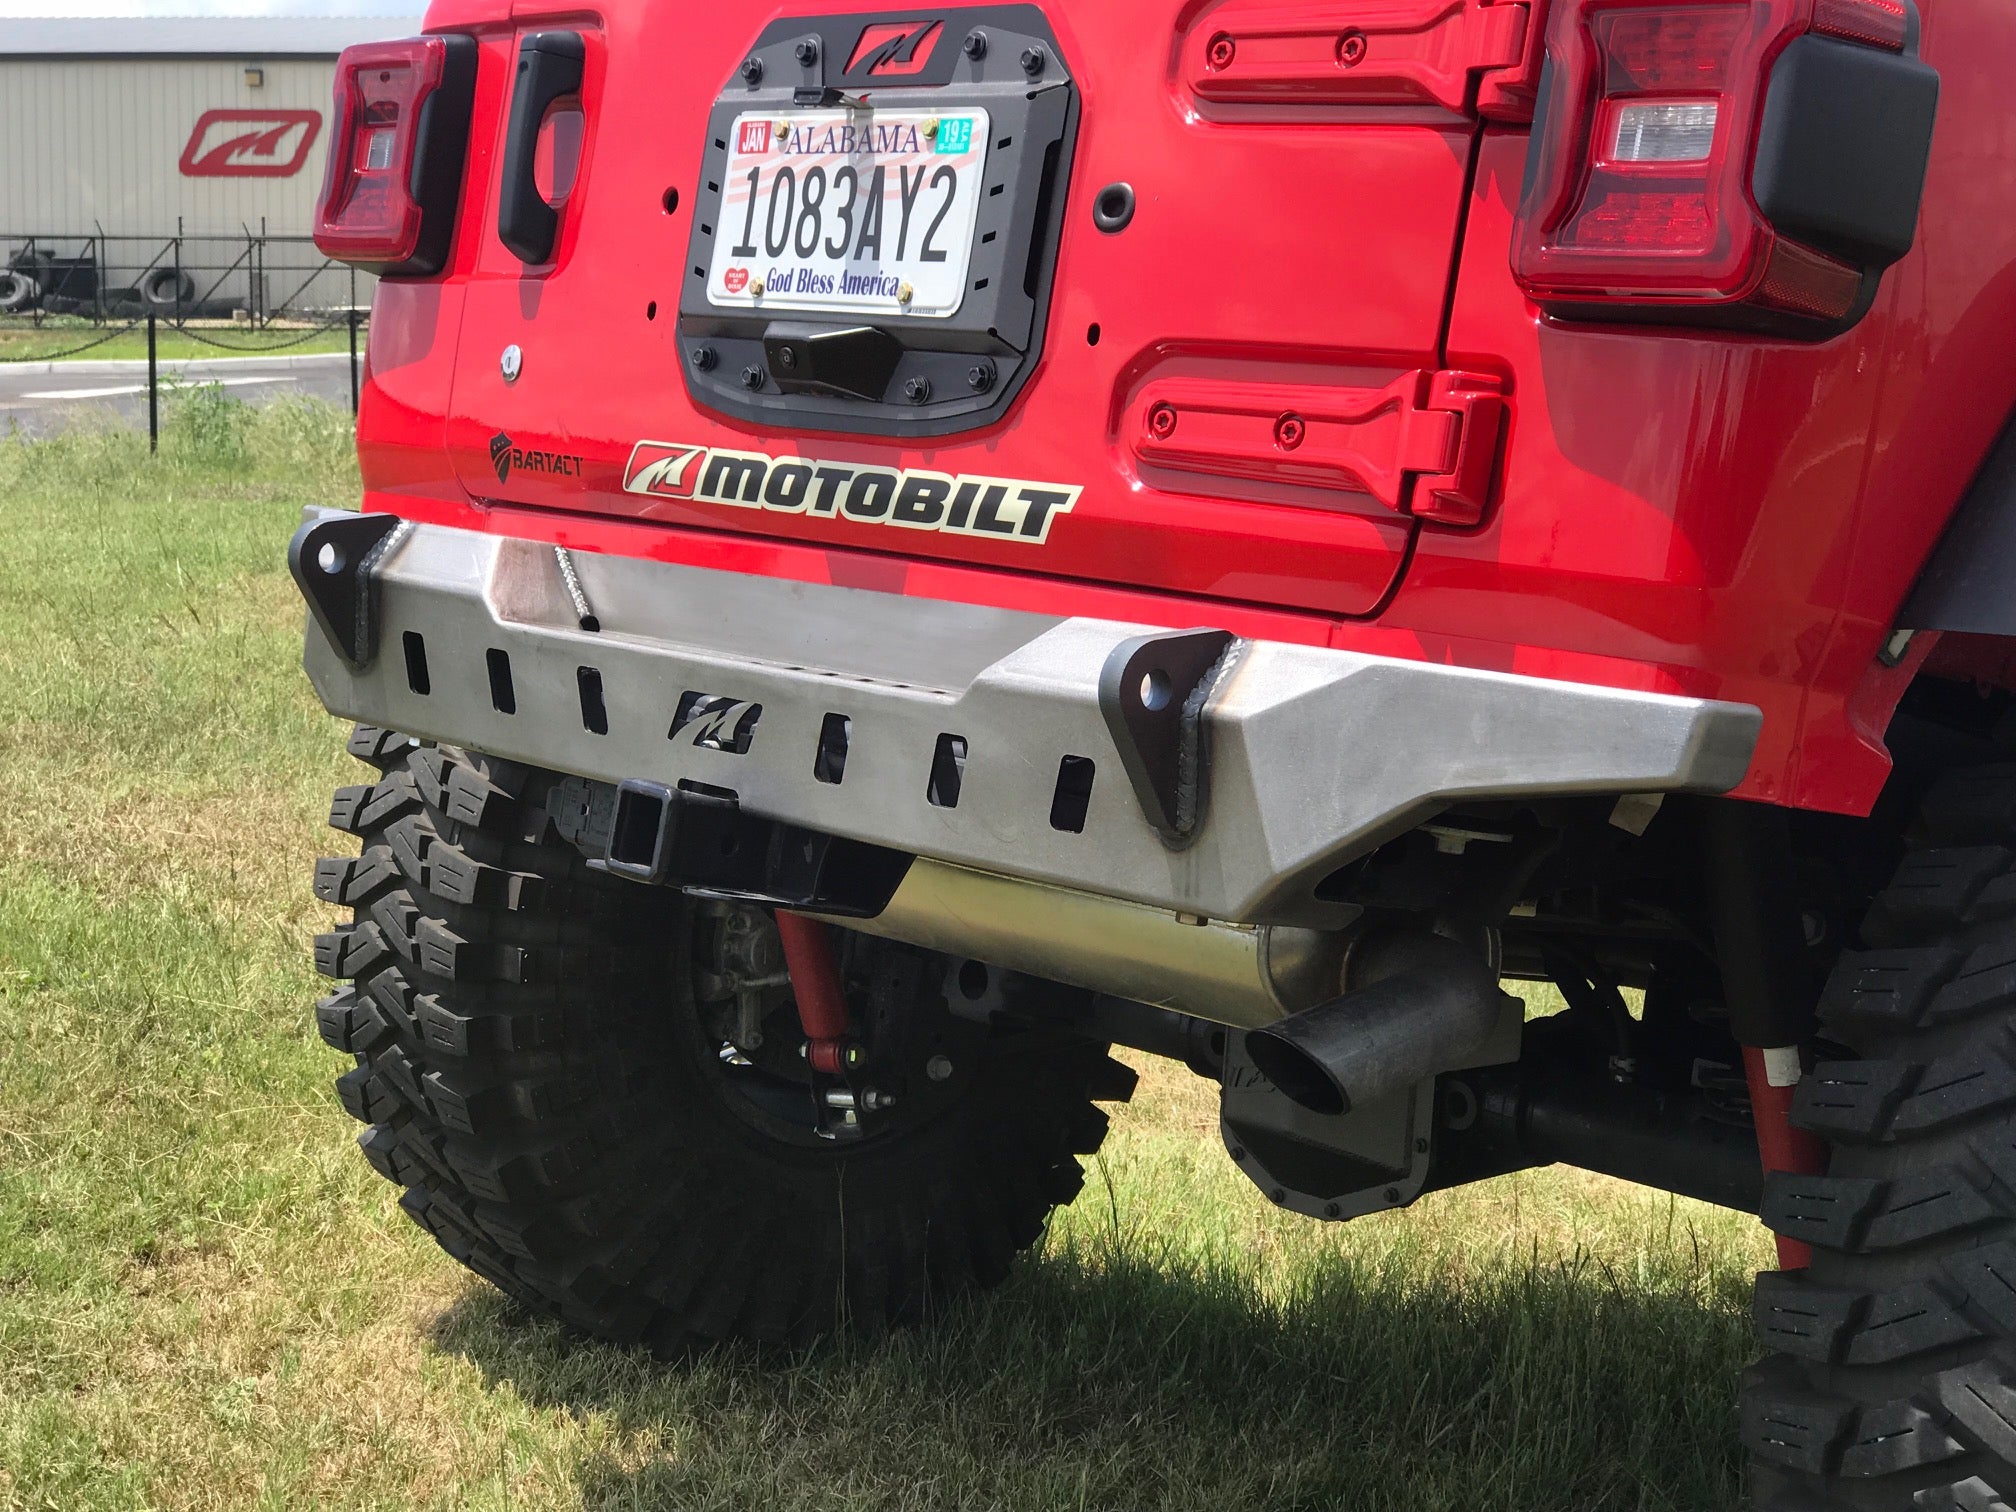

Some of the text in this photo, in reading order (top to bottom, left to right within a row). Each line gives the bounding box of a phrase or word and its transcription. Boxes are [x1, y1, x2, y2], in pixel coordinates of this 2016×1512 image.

[742, 127, 766, 152] JAN
[784, 125, 920, 155] ALABAMA
[943, 120, 960, 143] 19
[731, 164, 958, 262] 1083AY2
[766, 267, 900, 297] God Bless America
[512, 447, 584, 477] BARTACT
[700, 455, 1071, 538] MOTOBILT
